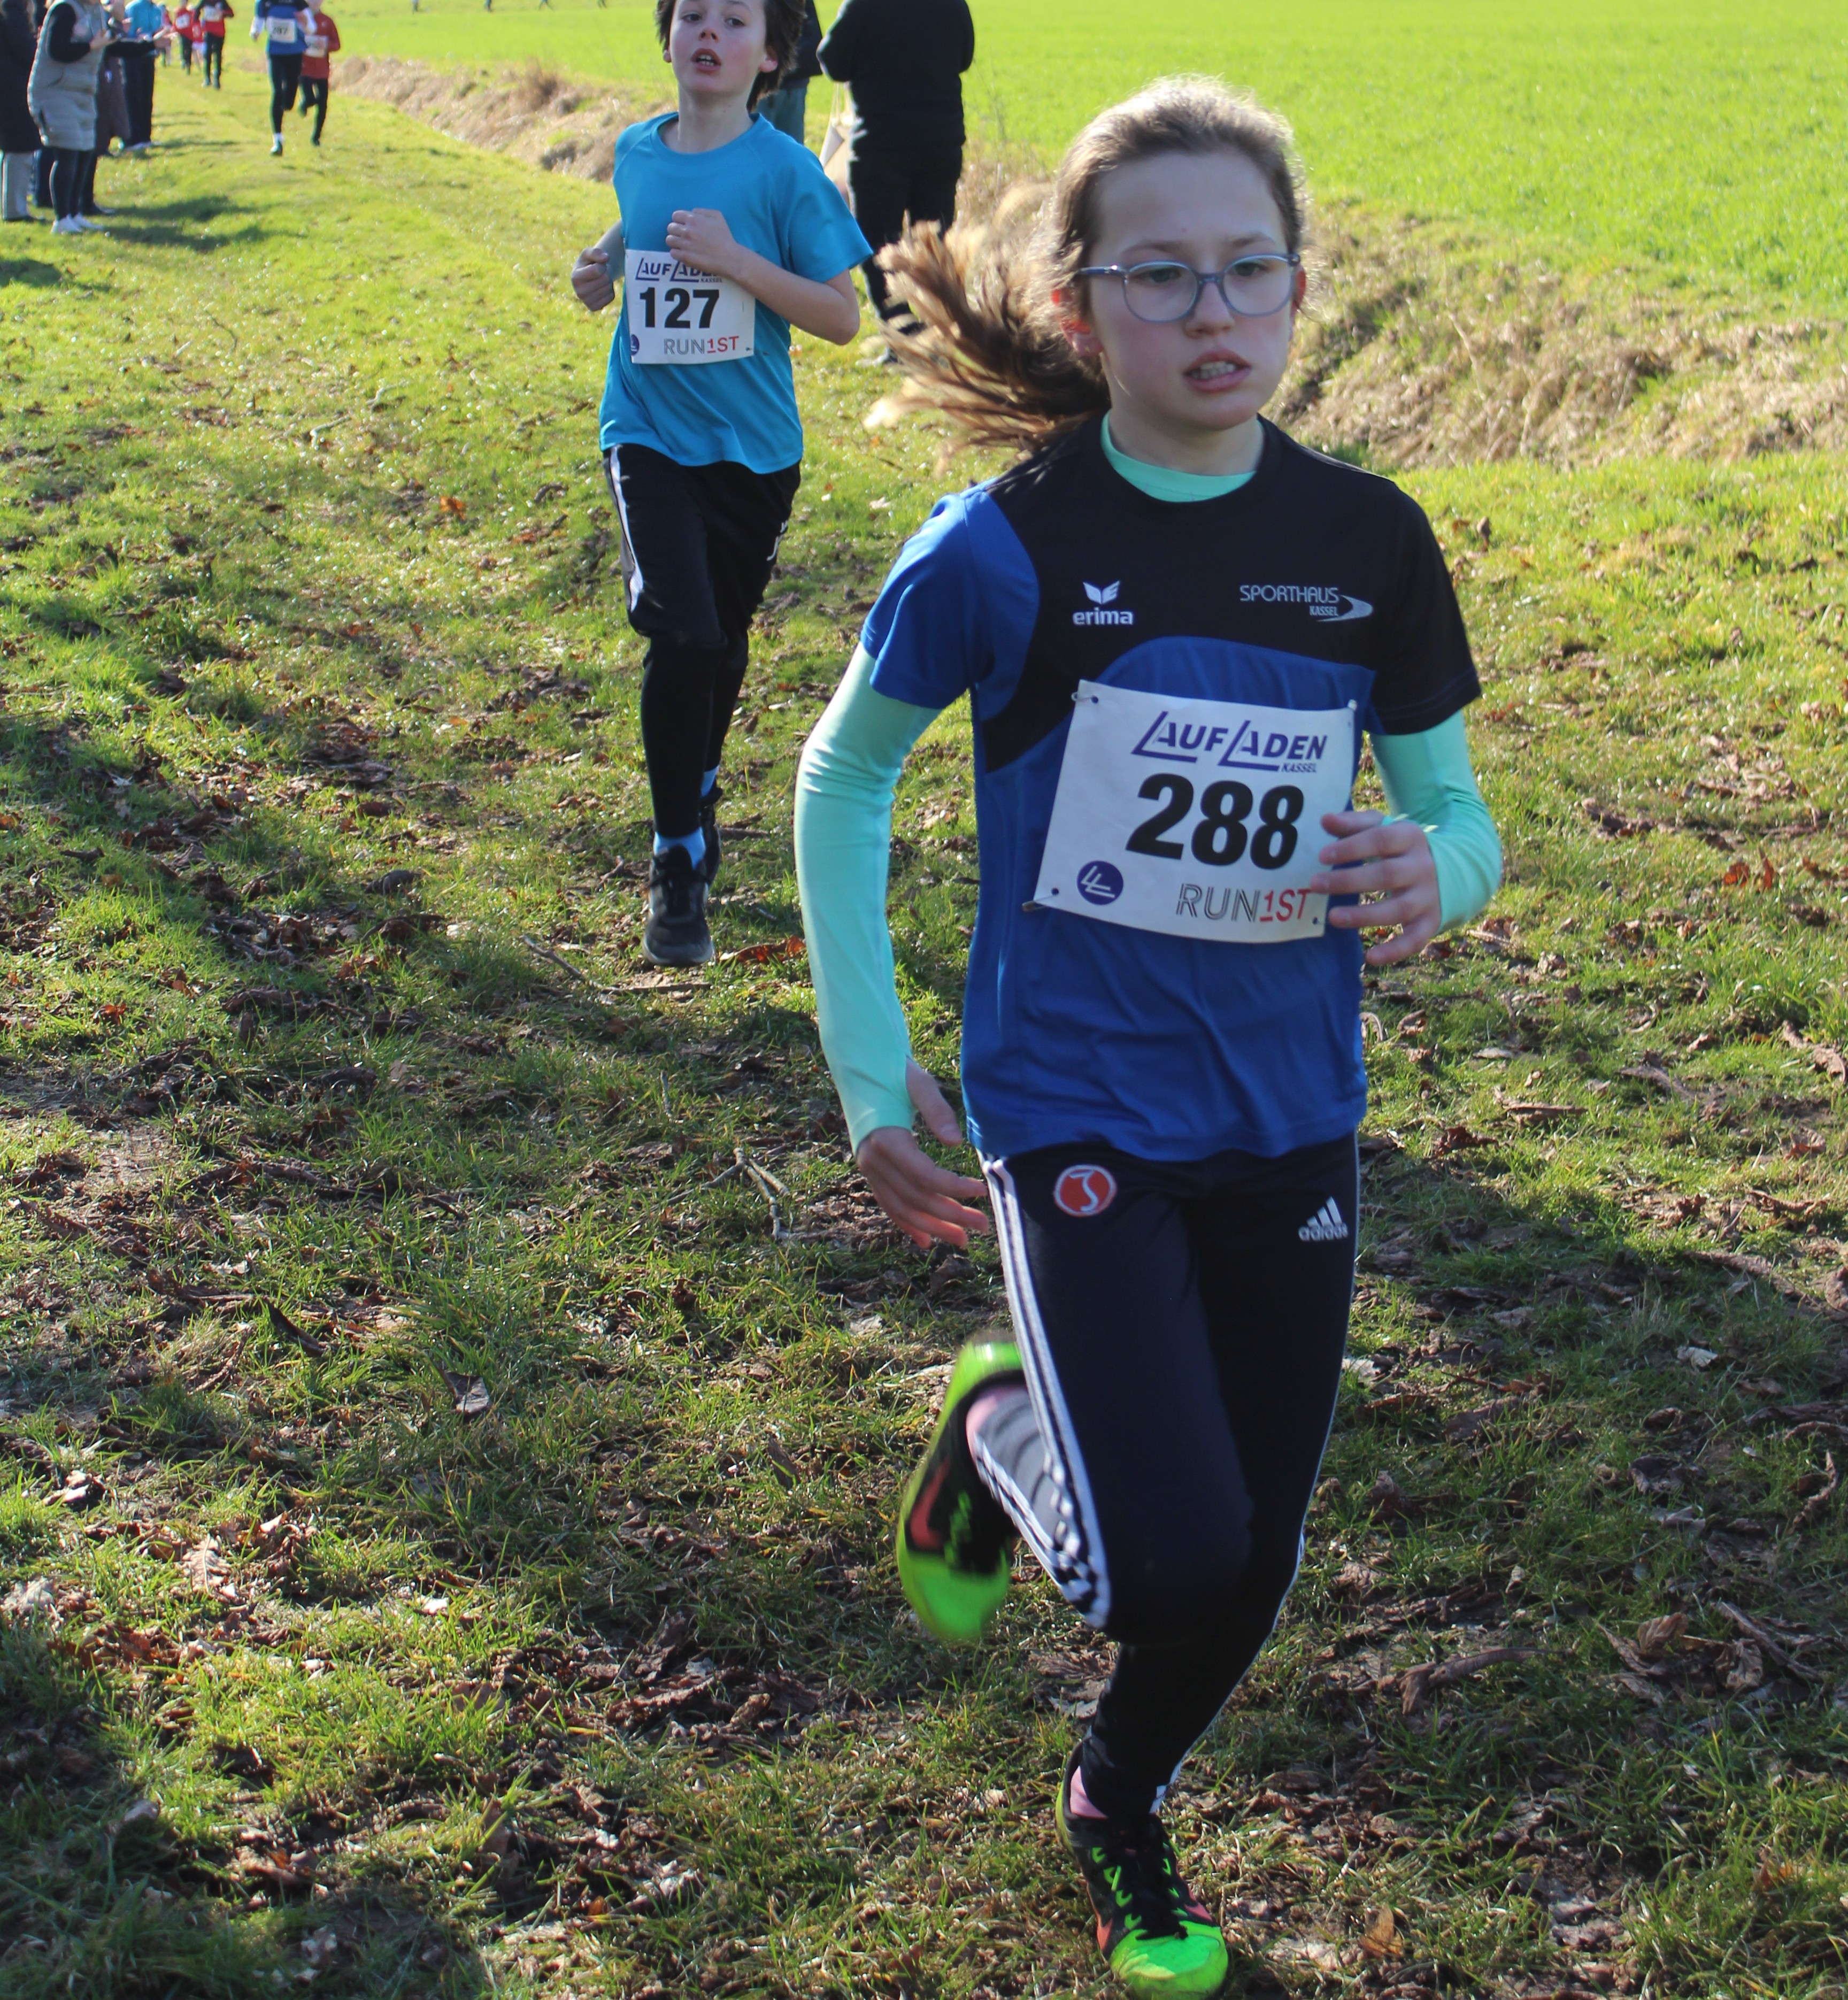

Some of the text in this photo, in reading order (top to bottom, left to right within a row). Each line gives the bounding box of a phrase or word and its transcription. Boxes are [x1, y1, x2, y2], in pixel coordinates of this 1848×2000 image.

[635, 257, 719, 282] LAUFLAD
[640, 287, 719, 329] 127
[1239, 584, 1339, 603] SPORTHAUS
[1073, 607, 1134, 625] erima
[1310, 605, 1338, 616] KASSEL
[1282, 763, 1317, 773] KASSEL
[1125, 773, 1304, 869] 288
[1298, 1221, 1348, 1241] adidas
